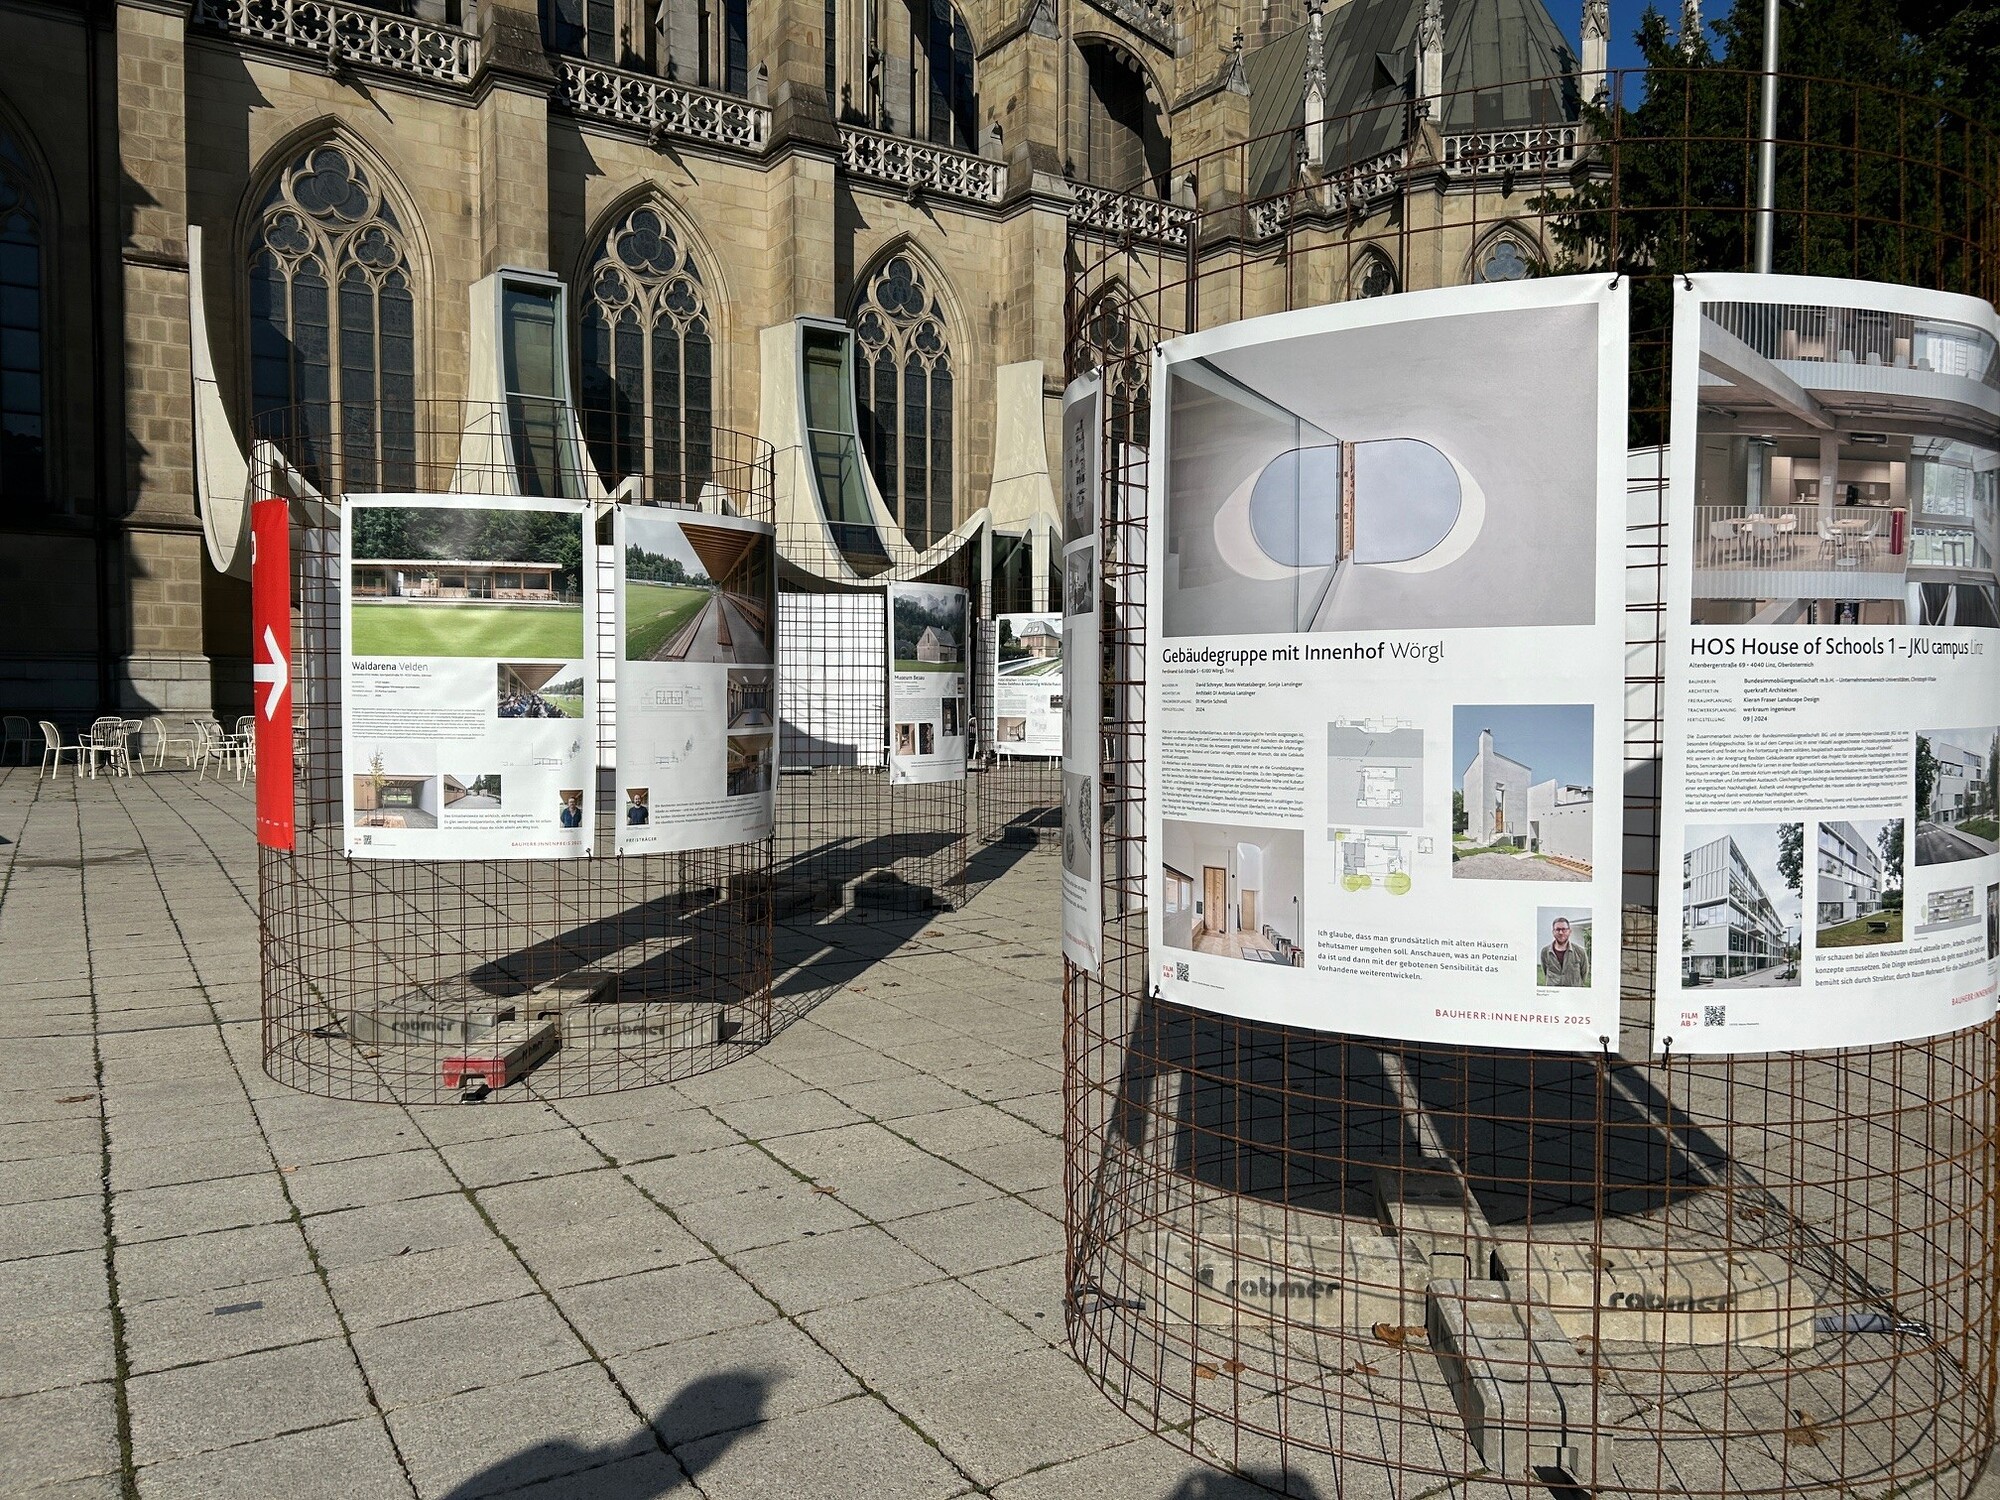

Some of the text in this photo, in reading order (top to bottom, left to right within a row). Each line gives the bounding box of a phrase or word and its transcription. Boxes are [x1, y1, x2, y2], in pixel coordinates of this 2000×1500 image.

[1162, 641, 1444, 666] Gebäudegruppe mit Innenhof Wörgl
[1691, 638, 1734, 655] HOS
[1742, 638, 1798, 655] House
[1804, 636, 1821, 654] of
[1826, 636, 1883, 654] Schools
[1888, 637, 1893, 654] 1
[1907, 637, 1931, 658] JKU
[1930, 642, 1970, 659] campus
[1970, 638, 1984, 655] Linz
[352, 661, 428, 671] Waldarena Velden
[1328, 930, 1354, 939] glaube,
[1389, 936, 1439, 945] grundsätzlich
[1440, 938, 1454, 946] mit
[1455, 939, 1475, 947] alten
[1476, 940, 1508, 948] Häusern
[1317, 941, 1358, 951] behutsamer
[1359, 946, 1391, 954] umgehen
[1409, 949, 1452, 959] Anschauen,
[1481, 953, 1517, 961] Potenzial
[1815, 953, 1826, 962] Wir
[1854, 951, 1863, 960] bei
[1865, 951, 1879, 959] allen
[1880, 949, 1908, 957] Neubauten
[1317, 952, 1326, 960] da
[1327, 953, 1336, 961] ist
[1352, 956, 1370, 964] dann
[1371, 957, 1383, 965] mit
[1399, 960, 1438, 969] gebotenen
[1439, 962, 1483, 972] Sensibilität
[1484, 965, 1498, 973] das
[1815, 966, 1844, 974] konzepte
[1845, 964, 1880, 972] umzusetzen.
[1881, 961, 1890, 969] Die
[1891, 960, 1906, 969] Dinge
[1907, 958, 1930, 966] verändern
[1317, 964, 1422, 980] Vorhandene weiterentwickeln.
[1815, 978, 1839, 986] bemüht
[1840, 977, 1853, 985] sich
[1854, 976, 1871, 984] durch
[1872, 974, 1895, 982] Struktur,
[1896, 972, 1910, 980] durch
[1435, 1009, 1591, 1024] BAUHERR:INNENPREIS 2025
